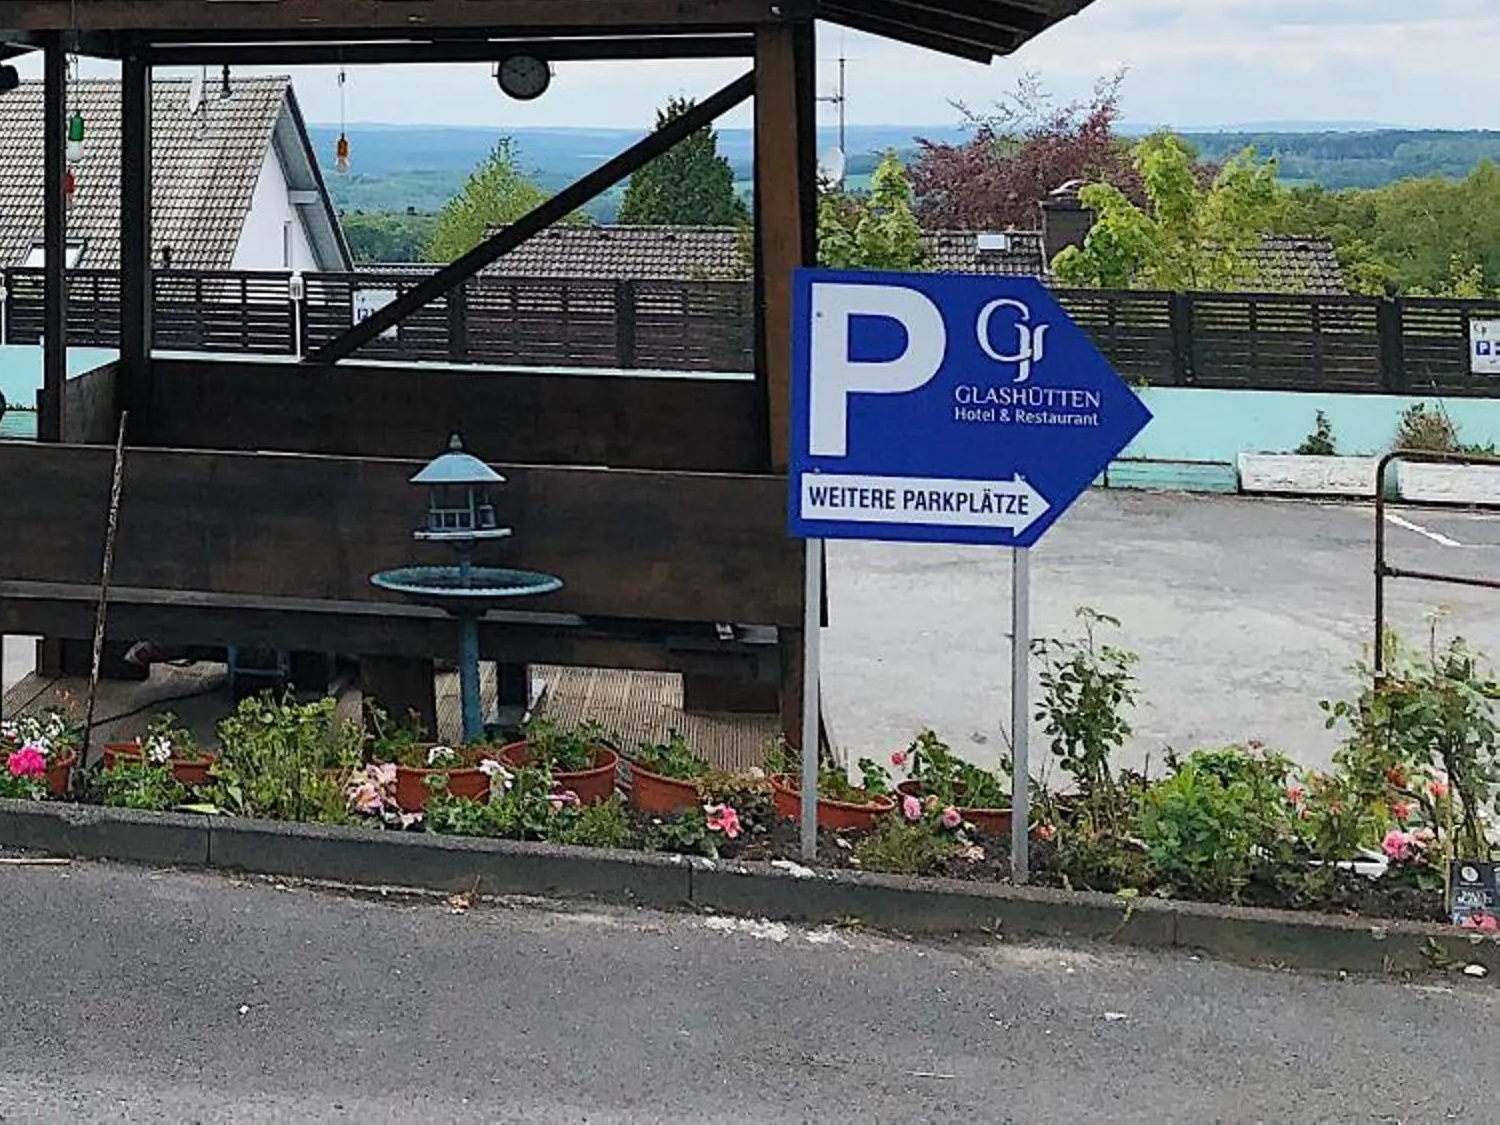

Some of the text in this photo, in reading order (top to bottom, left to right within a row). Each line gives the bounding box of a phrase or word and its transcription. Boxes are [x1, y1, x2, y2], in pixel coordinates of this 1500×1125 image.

[809, 282, 947, 457] P
[955, 407, 1100, 425] Hotel & Restaurant
[809, 486, 1029, 515] WEITERE PARKPLÄTZE
